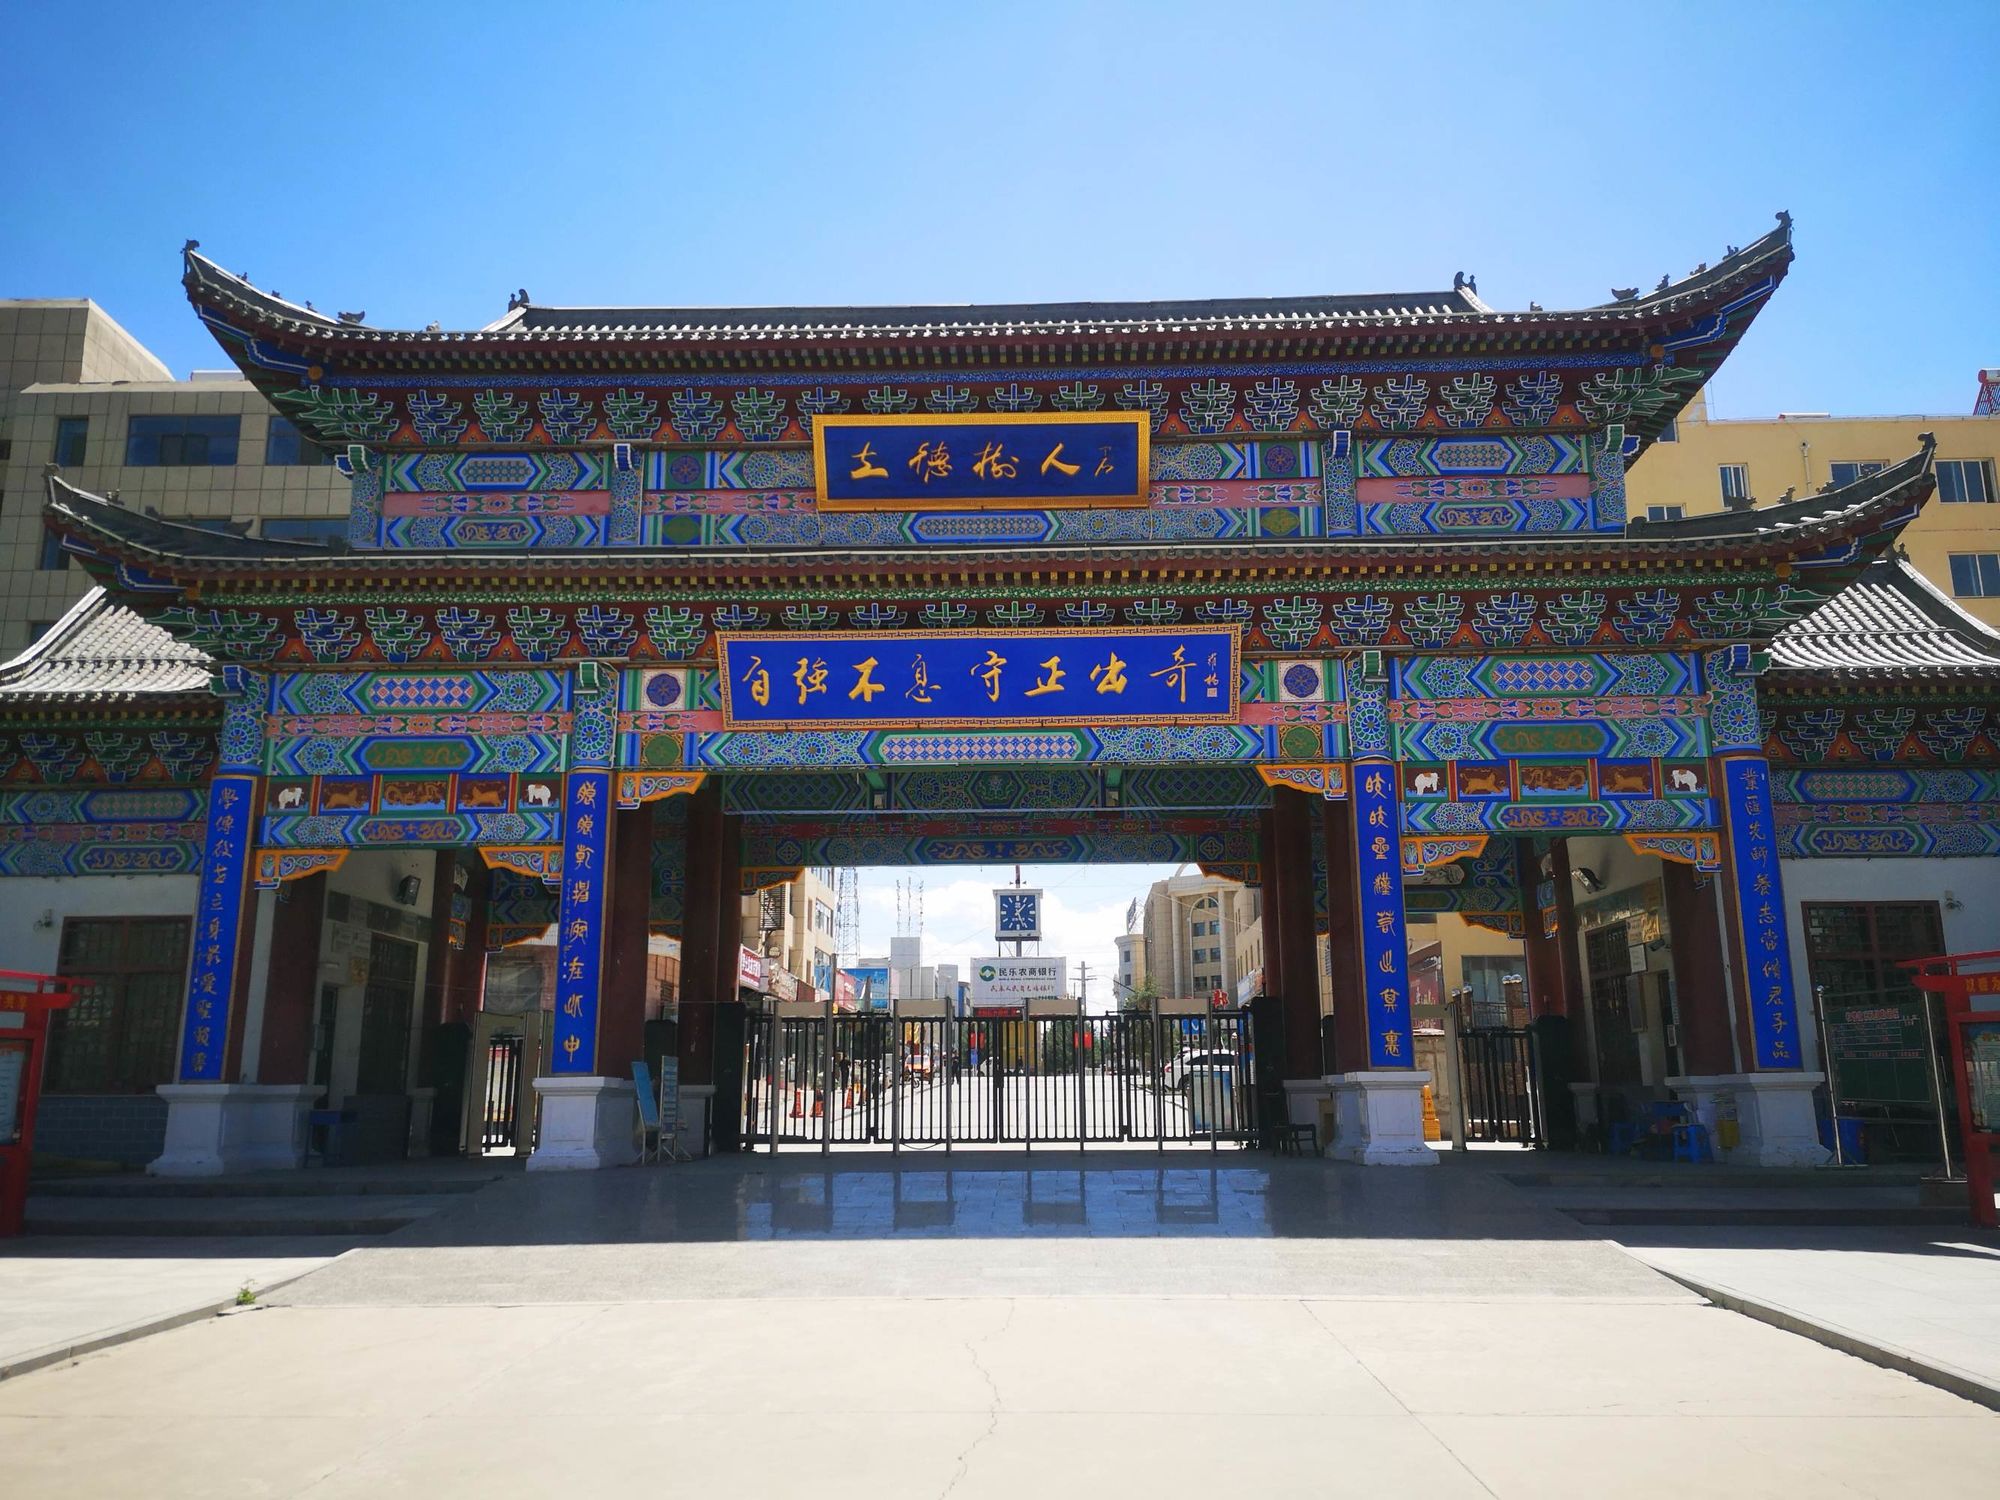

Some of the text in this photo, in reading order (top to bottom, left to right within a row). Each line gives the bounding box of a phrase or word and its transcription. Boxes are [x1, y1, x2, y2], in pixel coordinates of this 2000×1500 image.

[998, 967, 1057, 977] 民乐农商银行
